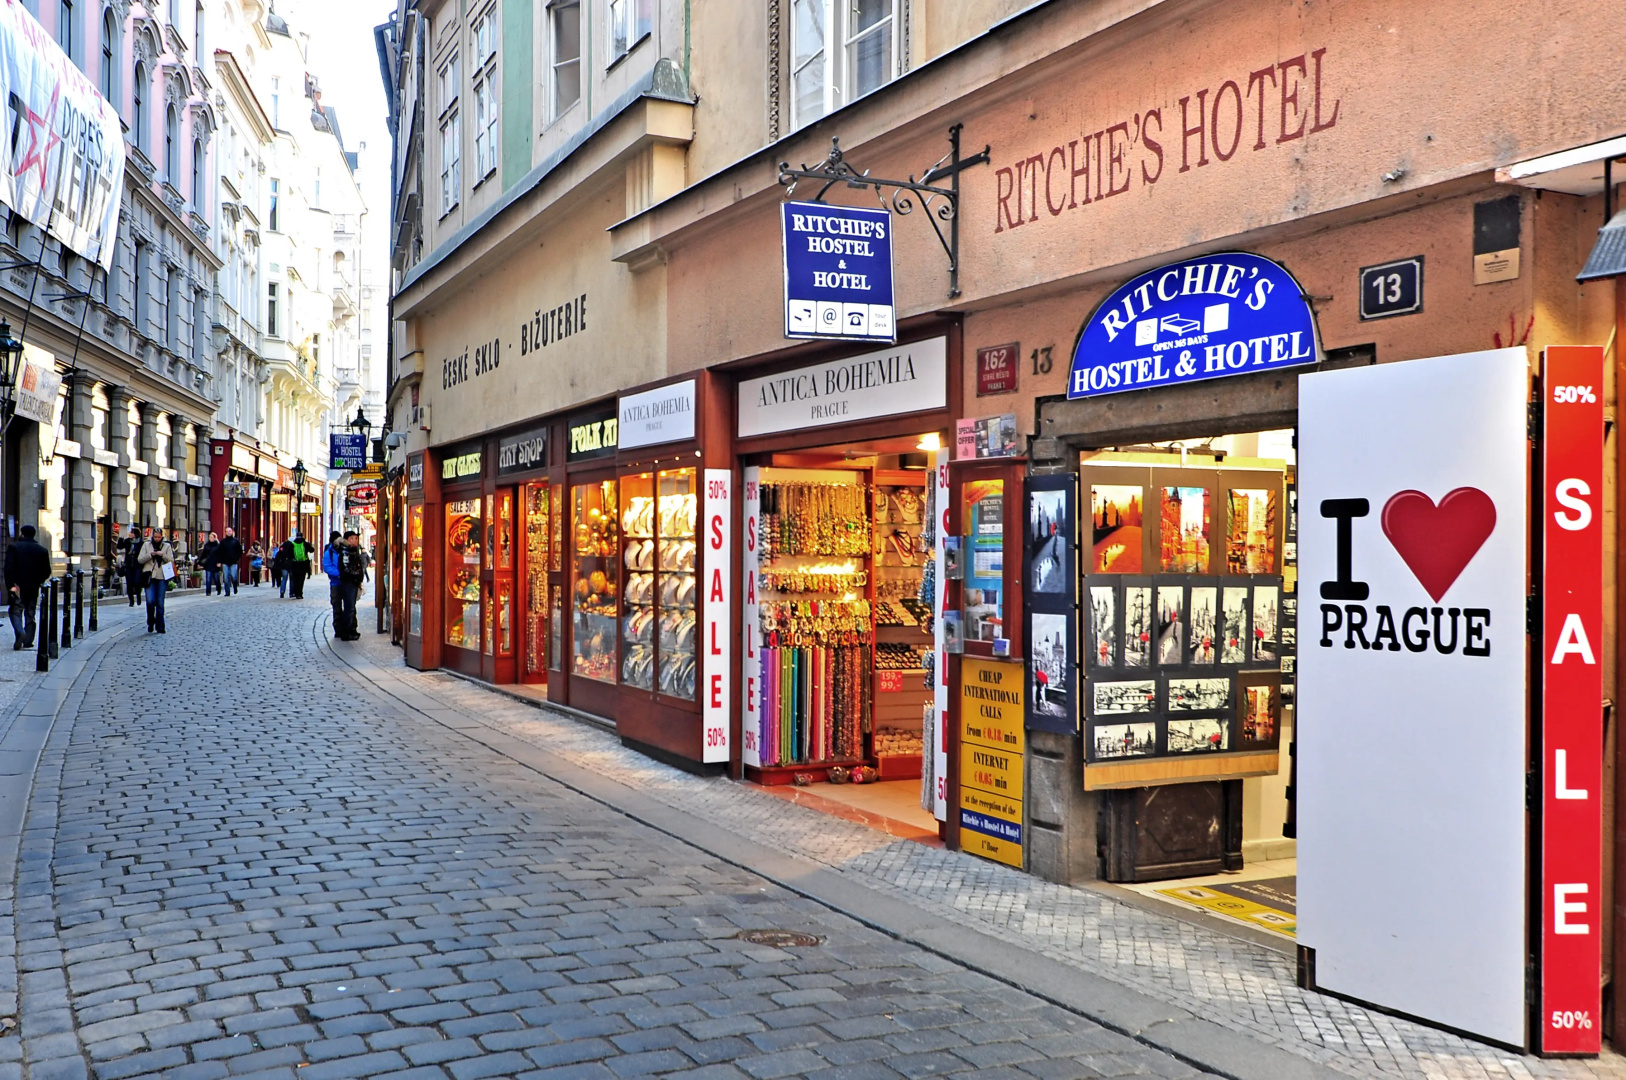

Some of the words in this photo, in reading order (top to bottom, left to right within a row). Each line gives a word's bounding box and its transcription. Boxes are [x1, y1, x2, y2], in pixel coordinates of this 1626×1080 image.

[995, 107, 1164, 234] RITCHIE'S
[1178, 47, 1341, 173] HOTEL
[792, 213, 885, 239] RITCHIE'S
[807, 236, 874, 257] HOSTEL
[838, 259, 847, 269] &
[813, 271, 871, 290] HOTEL
[1372, 273, 1402, 304] 13
[1101, 263, 1274, 343] RITCHIE'S
[442, 344, 468, 390] ČESKÉ
[475, 337, 500, 376] SKLO
[521, 293, 587, 356] BIŽUTERIE
[1152, 341, 1174, 352] OPEN
[1187, 334, 1208, 346] DAYS
[984, 349, 1007, 371] 162
[1030, 346, 1053, 375] 13
[1073, 355, 1170, 393] HOSTEL
[1174, 350, 1197, 377] &
[1204, 331, 1311, 373] HOTEL
[757, 374, 819, 407] ANTICA
[824, 353, 917, 396] BOHEMIA
[1553, 385, 1597, 404] 50%
[622, 405, 650, 424] ANTICA
[652, 396, 690, 419] BOHEMIA
[810, 400, 849, 420] PRAGUE
[334, 435, 353, 446] HOTEL
[571, 421, 602, 454] FOLK
[957, 435, 975, 445] OFFER
[340, 446, 363, 457] HOSTEL
[499, 444, 518, 469] ART
[518, 437, 544, 467] SHOP
[939, 464, 949, 489] 50
[708, 480, 728, 500] 50%
[746, 481, 758, 501] 50%
[450, 501, 464, 514] SALE
[1319, 497, 1370, 601] I
[710, 514, 725, 709] SALE
[747, 516, 756, 713] SALE
[1319, 603, 1492, 658] PRAGUE
[978, 670, 1003, 685] CHEAP
[964, 684, 1020, 705] INTERNATIONAL
[980, 704, 1002, 720] CALLS
[1551, 477, 1597, 937] SALE
[706, 727, 726, 748] 50%
[745, 730, 757, 751] 50%
[966, 723, 982, 738] from
[973, 751, 1009, 771] INTERNET
[938, 776, 948, 801] 50
[964, 795, 970, 803] at
[1002, 804, 1008, 814] of
[1008, 805, 1016, 816] the
[1551, 1010, 1593, 1031] 50%
